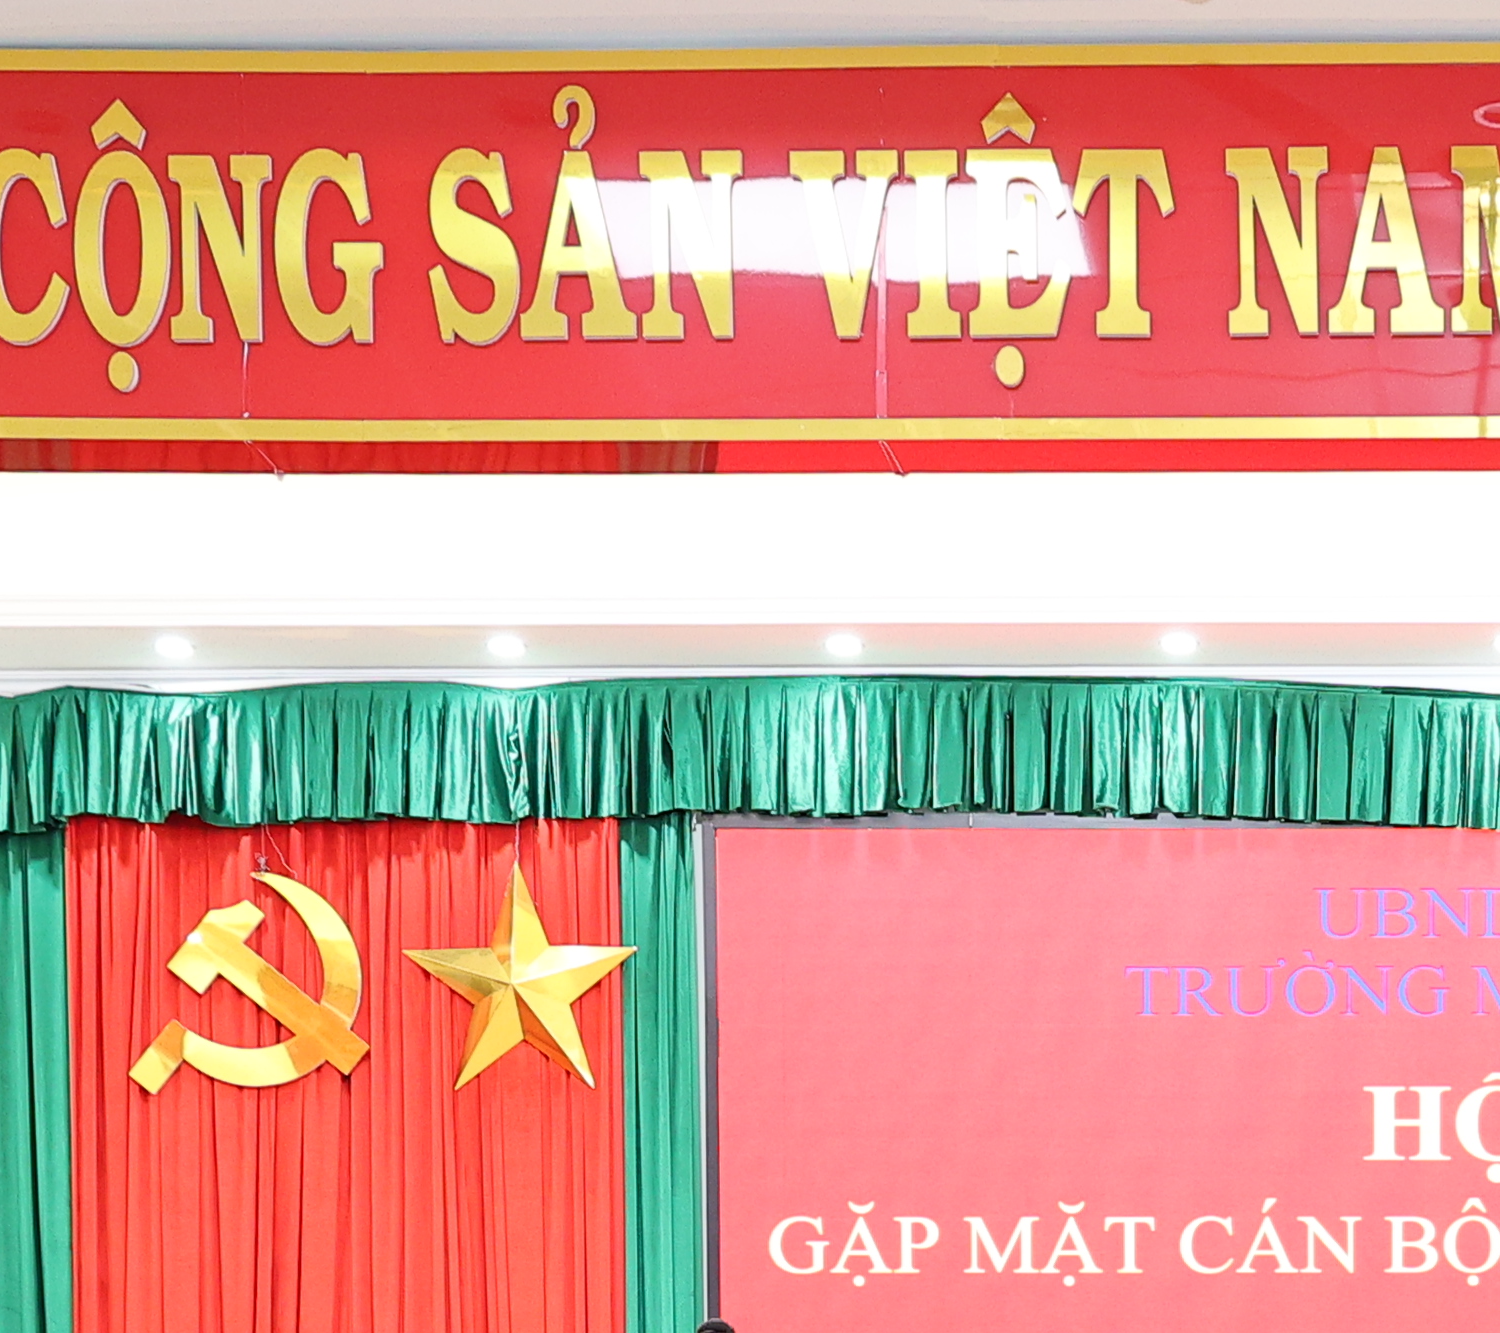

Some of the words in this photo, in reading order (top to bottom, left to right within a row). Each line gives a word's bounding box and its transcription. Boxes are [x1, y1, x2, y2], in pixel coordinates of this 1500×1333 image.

[428, 85, 745, 346] SẢN
[787, 91, 1177, 388] VIỆT
[1124, 949, 1448, 1018] TRƯỜNG
[768, 1201, 940, 1287] GẶP
[963, 1201, 1156, 1287] MẶT
[1179, 1197, 1362, 1275] CÁN
